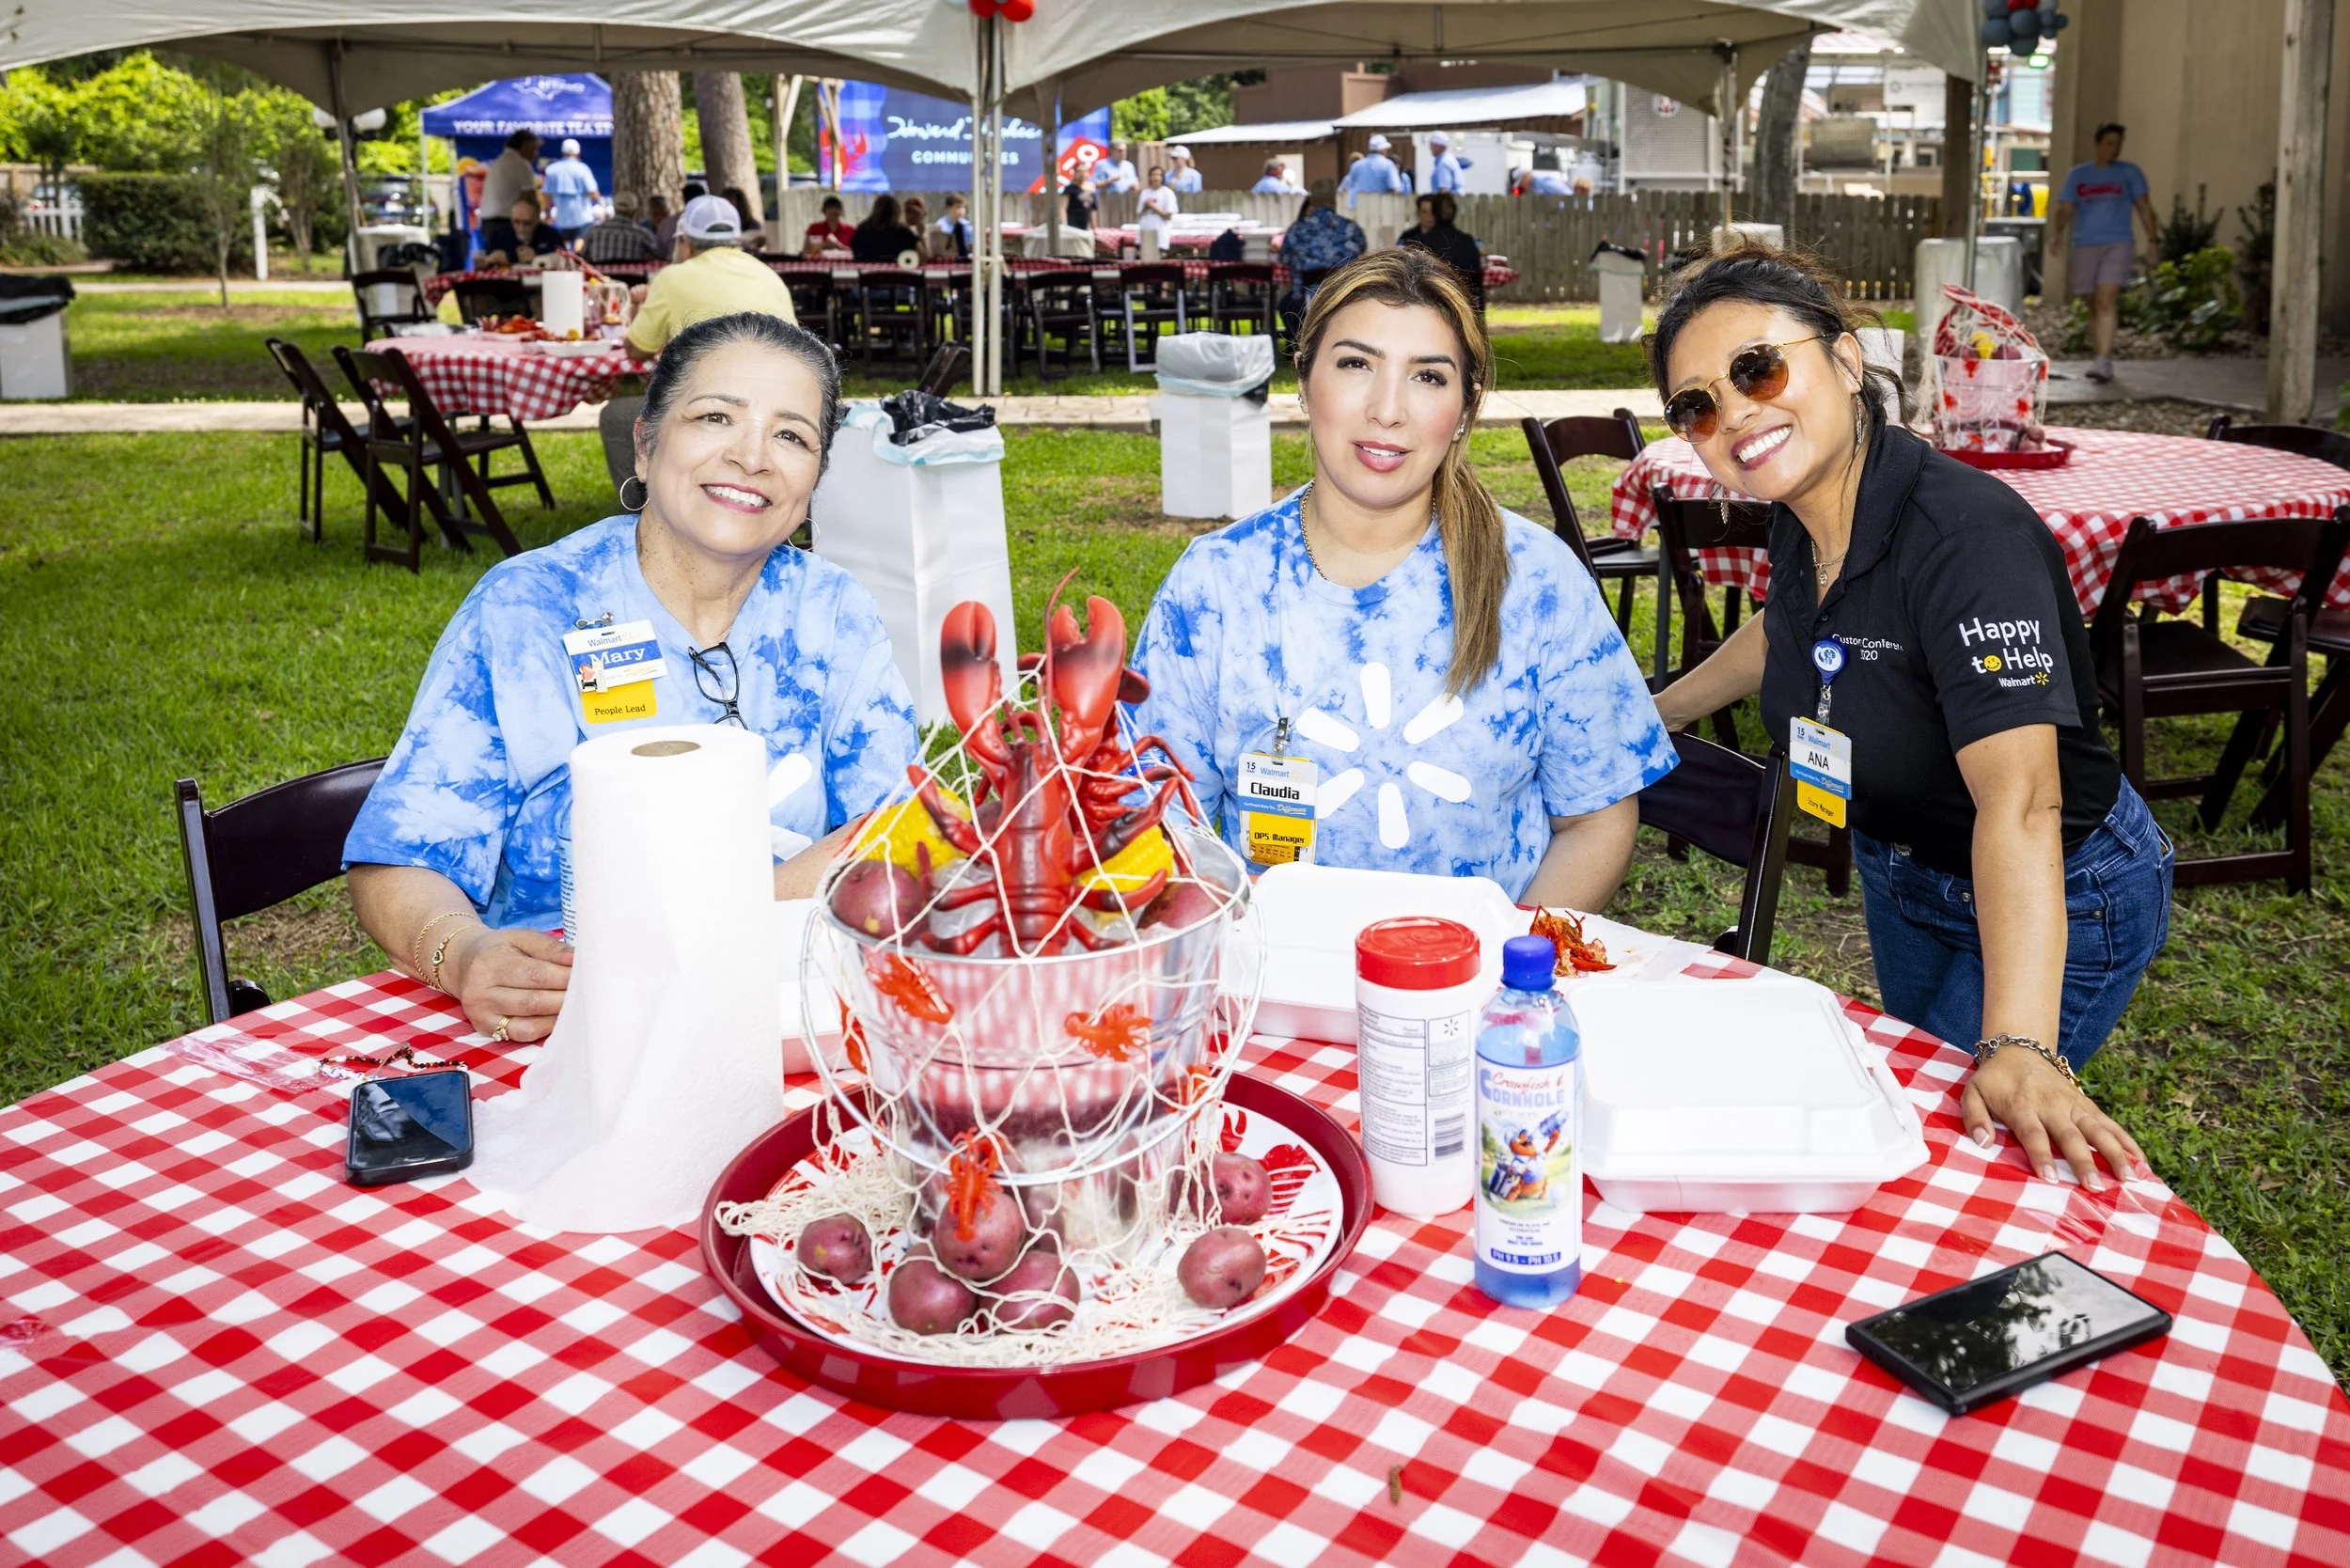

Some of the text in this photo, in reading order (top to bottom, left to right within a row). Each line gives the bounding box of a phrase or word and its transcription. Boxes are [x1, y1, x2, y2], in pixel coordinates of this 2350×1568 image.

[452, 120, 495, 134] YOUR
[496, 120, 565, 135] FAVORITE
[566, 120, 594, 135] TEA
[911, 150, 1020, 165] COMMUES
[1959, 618, 2041, 647] Happy
[588, 635, 622, 648] Walmart
[588, 648, 646, 665] Mary
[2002, 646, 2054, 673] Help
[1998, 675, 2036, 687] Walmart
[594, 704, 646, 715] People Lead
[1797, 727, 1805, 736] 15
[1808, 734, 1831, 750] Walmart
[1246, 761, 1256, 770] 15
[1808, 751, 1830, 770] ANA
[1261, 767, 1290, 778] Walmart
[1250, 782, 1300, 800] Claudia
[1254, 832, 1269, 840] OPS
[1272, 834, 1305, 843] Manager
[1480, 1067, 1564, 1107] CORNHOLE
[1493, 1072, 1550, 1095] Crawfish
